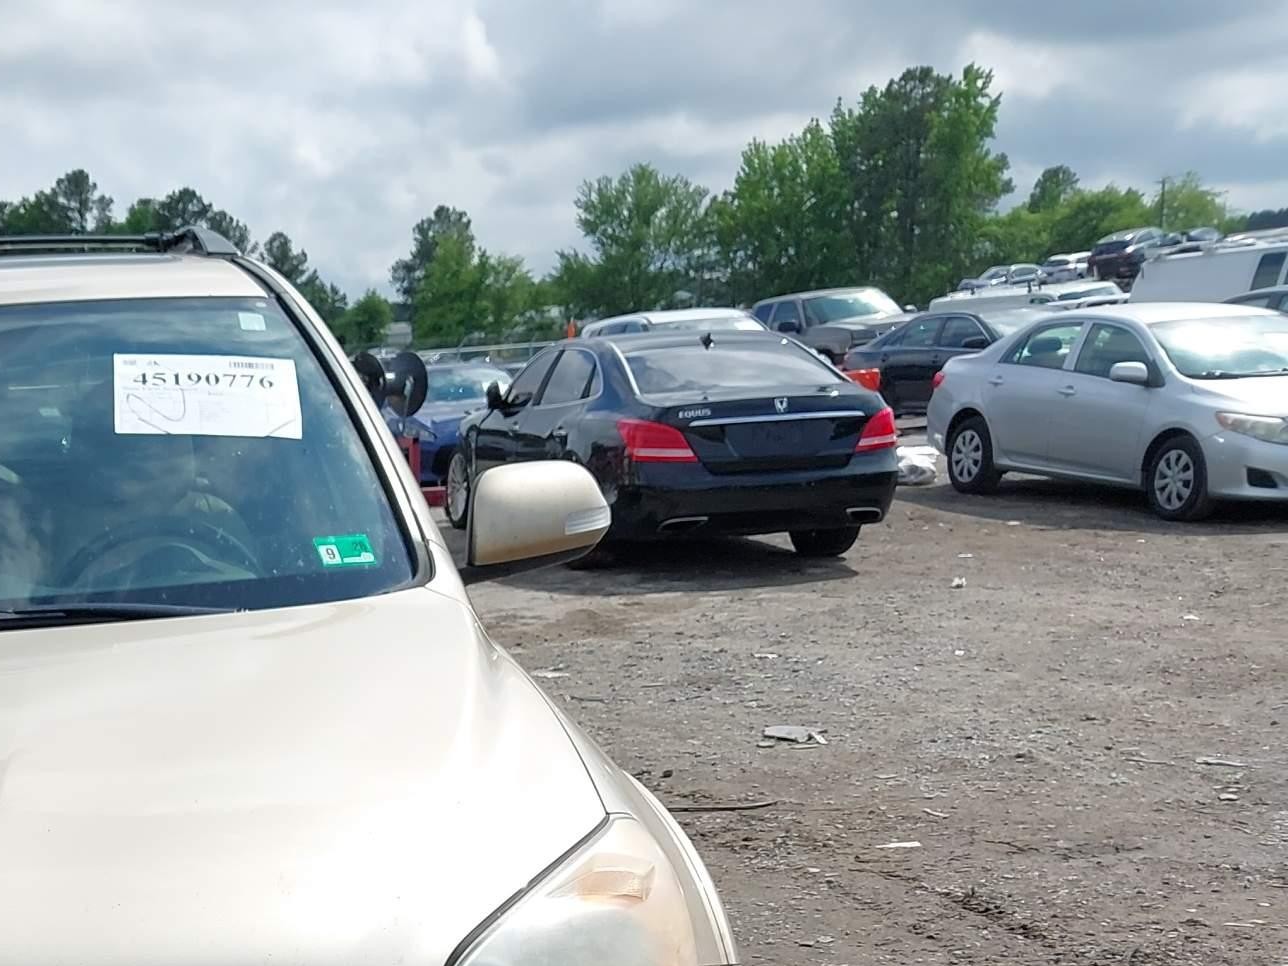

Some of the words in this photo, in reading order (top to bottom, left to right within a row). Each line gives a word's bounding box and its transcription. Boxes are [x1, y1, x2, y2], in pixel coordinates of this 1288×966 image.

[133, 372, 275, 389] 45190776
[678, 408, 711, 418] EQUUS
[326, 548, 336, 560] 9
